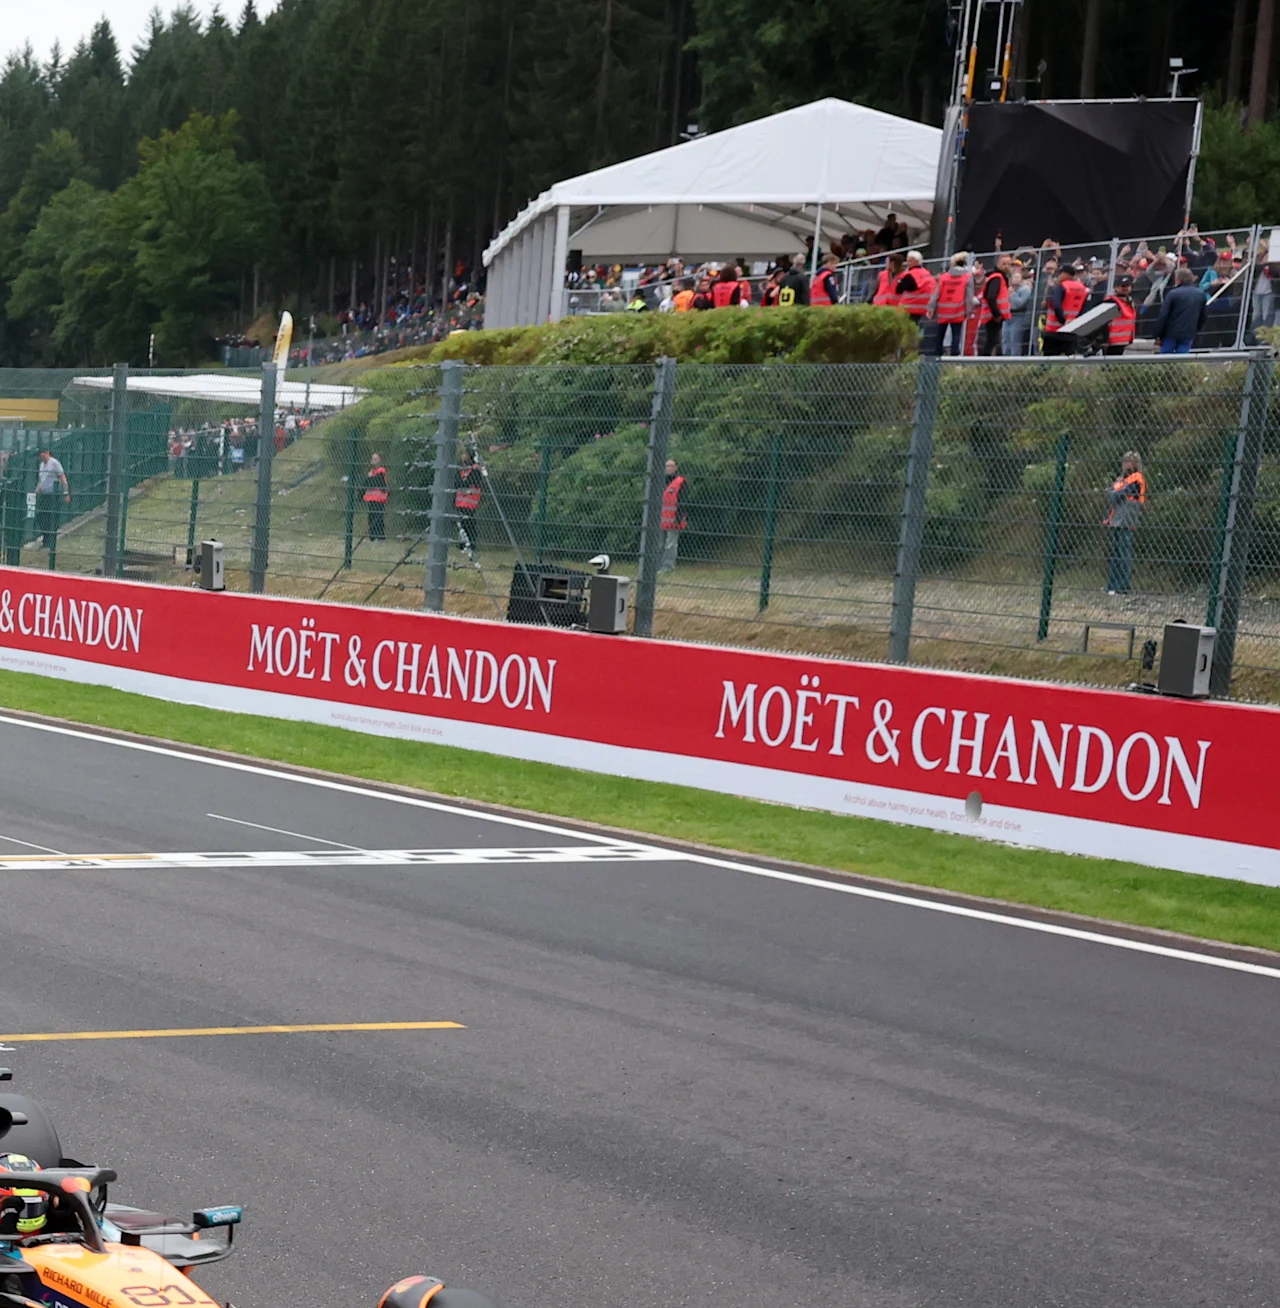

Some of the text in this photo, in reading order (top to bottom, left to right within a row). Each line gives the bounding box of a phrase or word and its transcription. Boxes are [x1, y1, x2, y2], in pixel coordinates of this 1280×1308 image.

[0, 590, 15, 634] &
[18, 593, 143, 653] CHANDON
[247, 617, 557, 713] MOËT & CHANDON
[715, 675, 1212, 809] MOËT & CHANDON
[43, 1267, 82, 1294] RICHARD
[120, 1285, 213, 1307] 81
